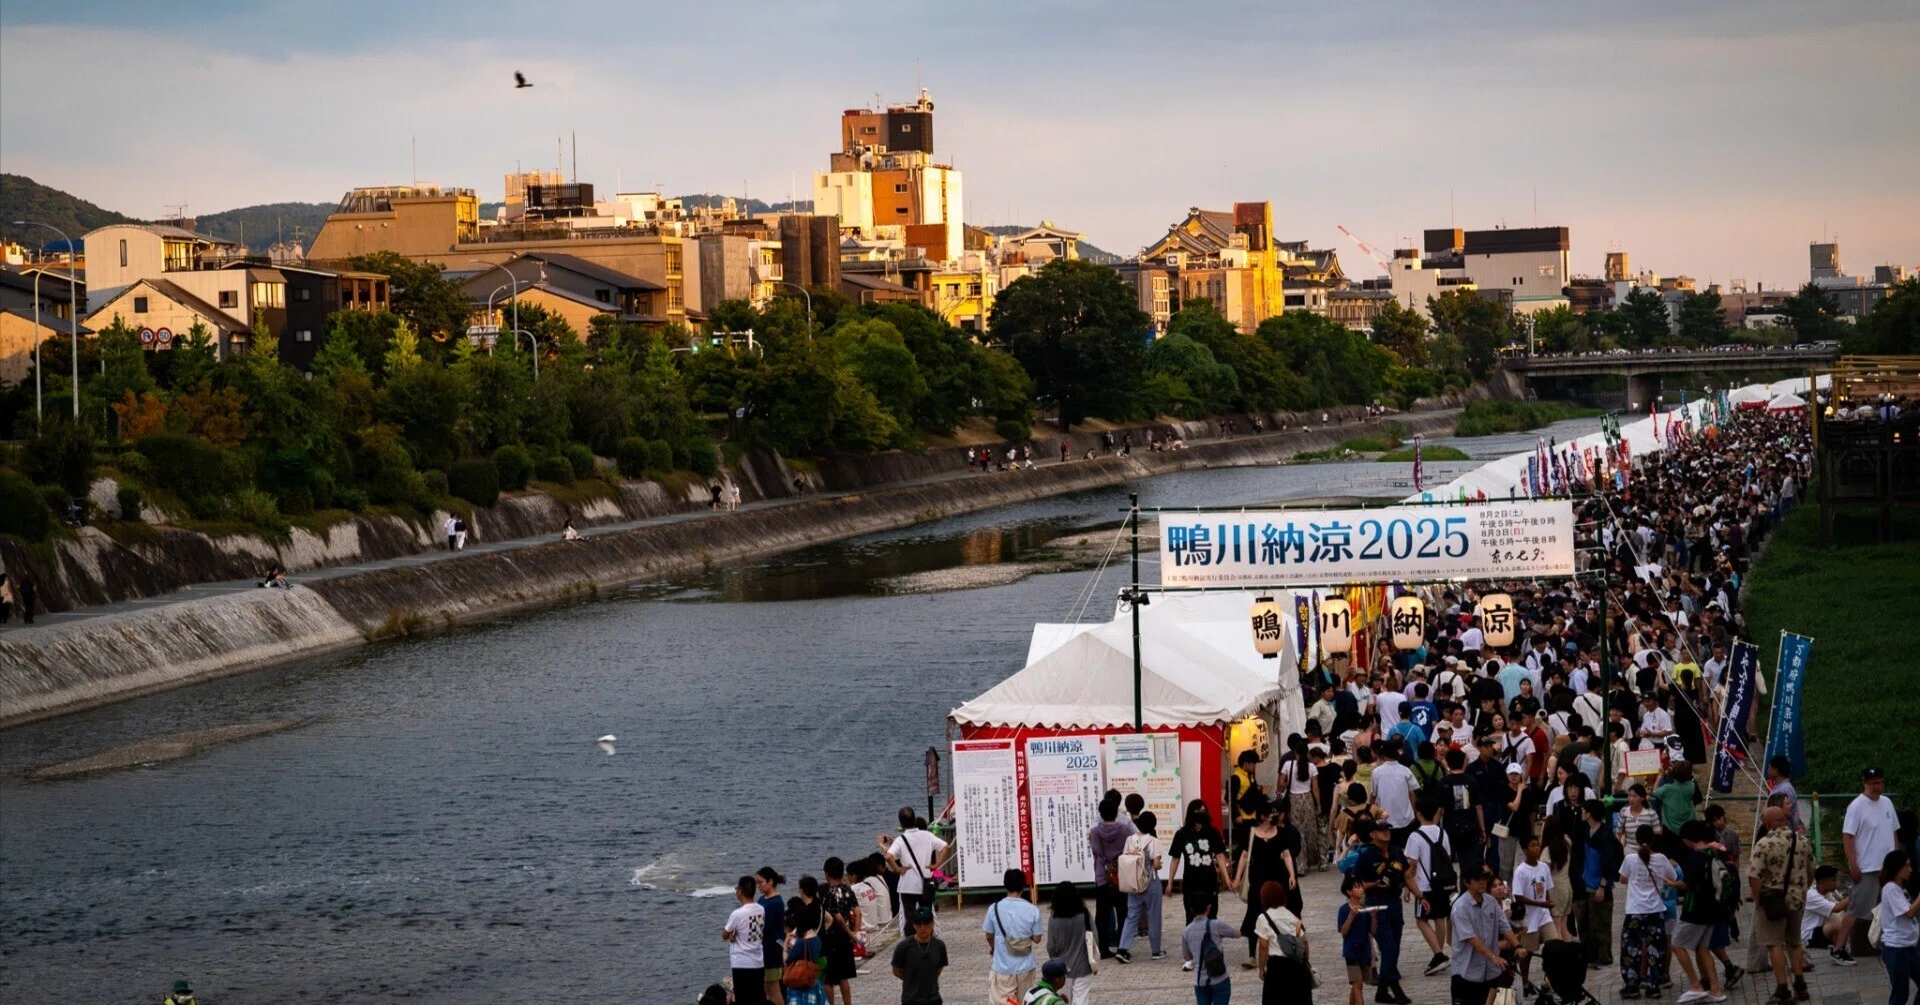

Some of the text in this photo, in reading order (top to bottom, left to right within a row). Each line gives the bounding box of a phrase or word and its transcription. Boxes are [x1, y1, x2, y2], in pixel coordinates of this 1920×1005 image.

[1168, 518, 1470, 566] 鴨川納涼2025
[1252, 609, 1281, 641] 鴨
[1322, 607, 1350, 638] 川
[1393, 606, 1422, 637] 納
[1483, 603, 1511, 634] 涼
[1030, 740, 1083, 755] 鴨川納涼
[1066, 755, 1098, 769] 2025
